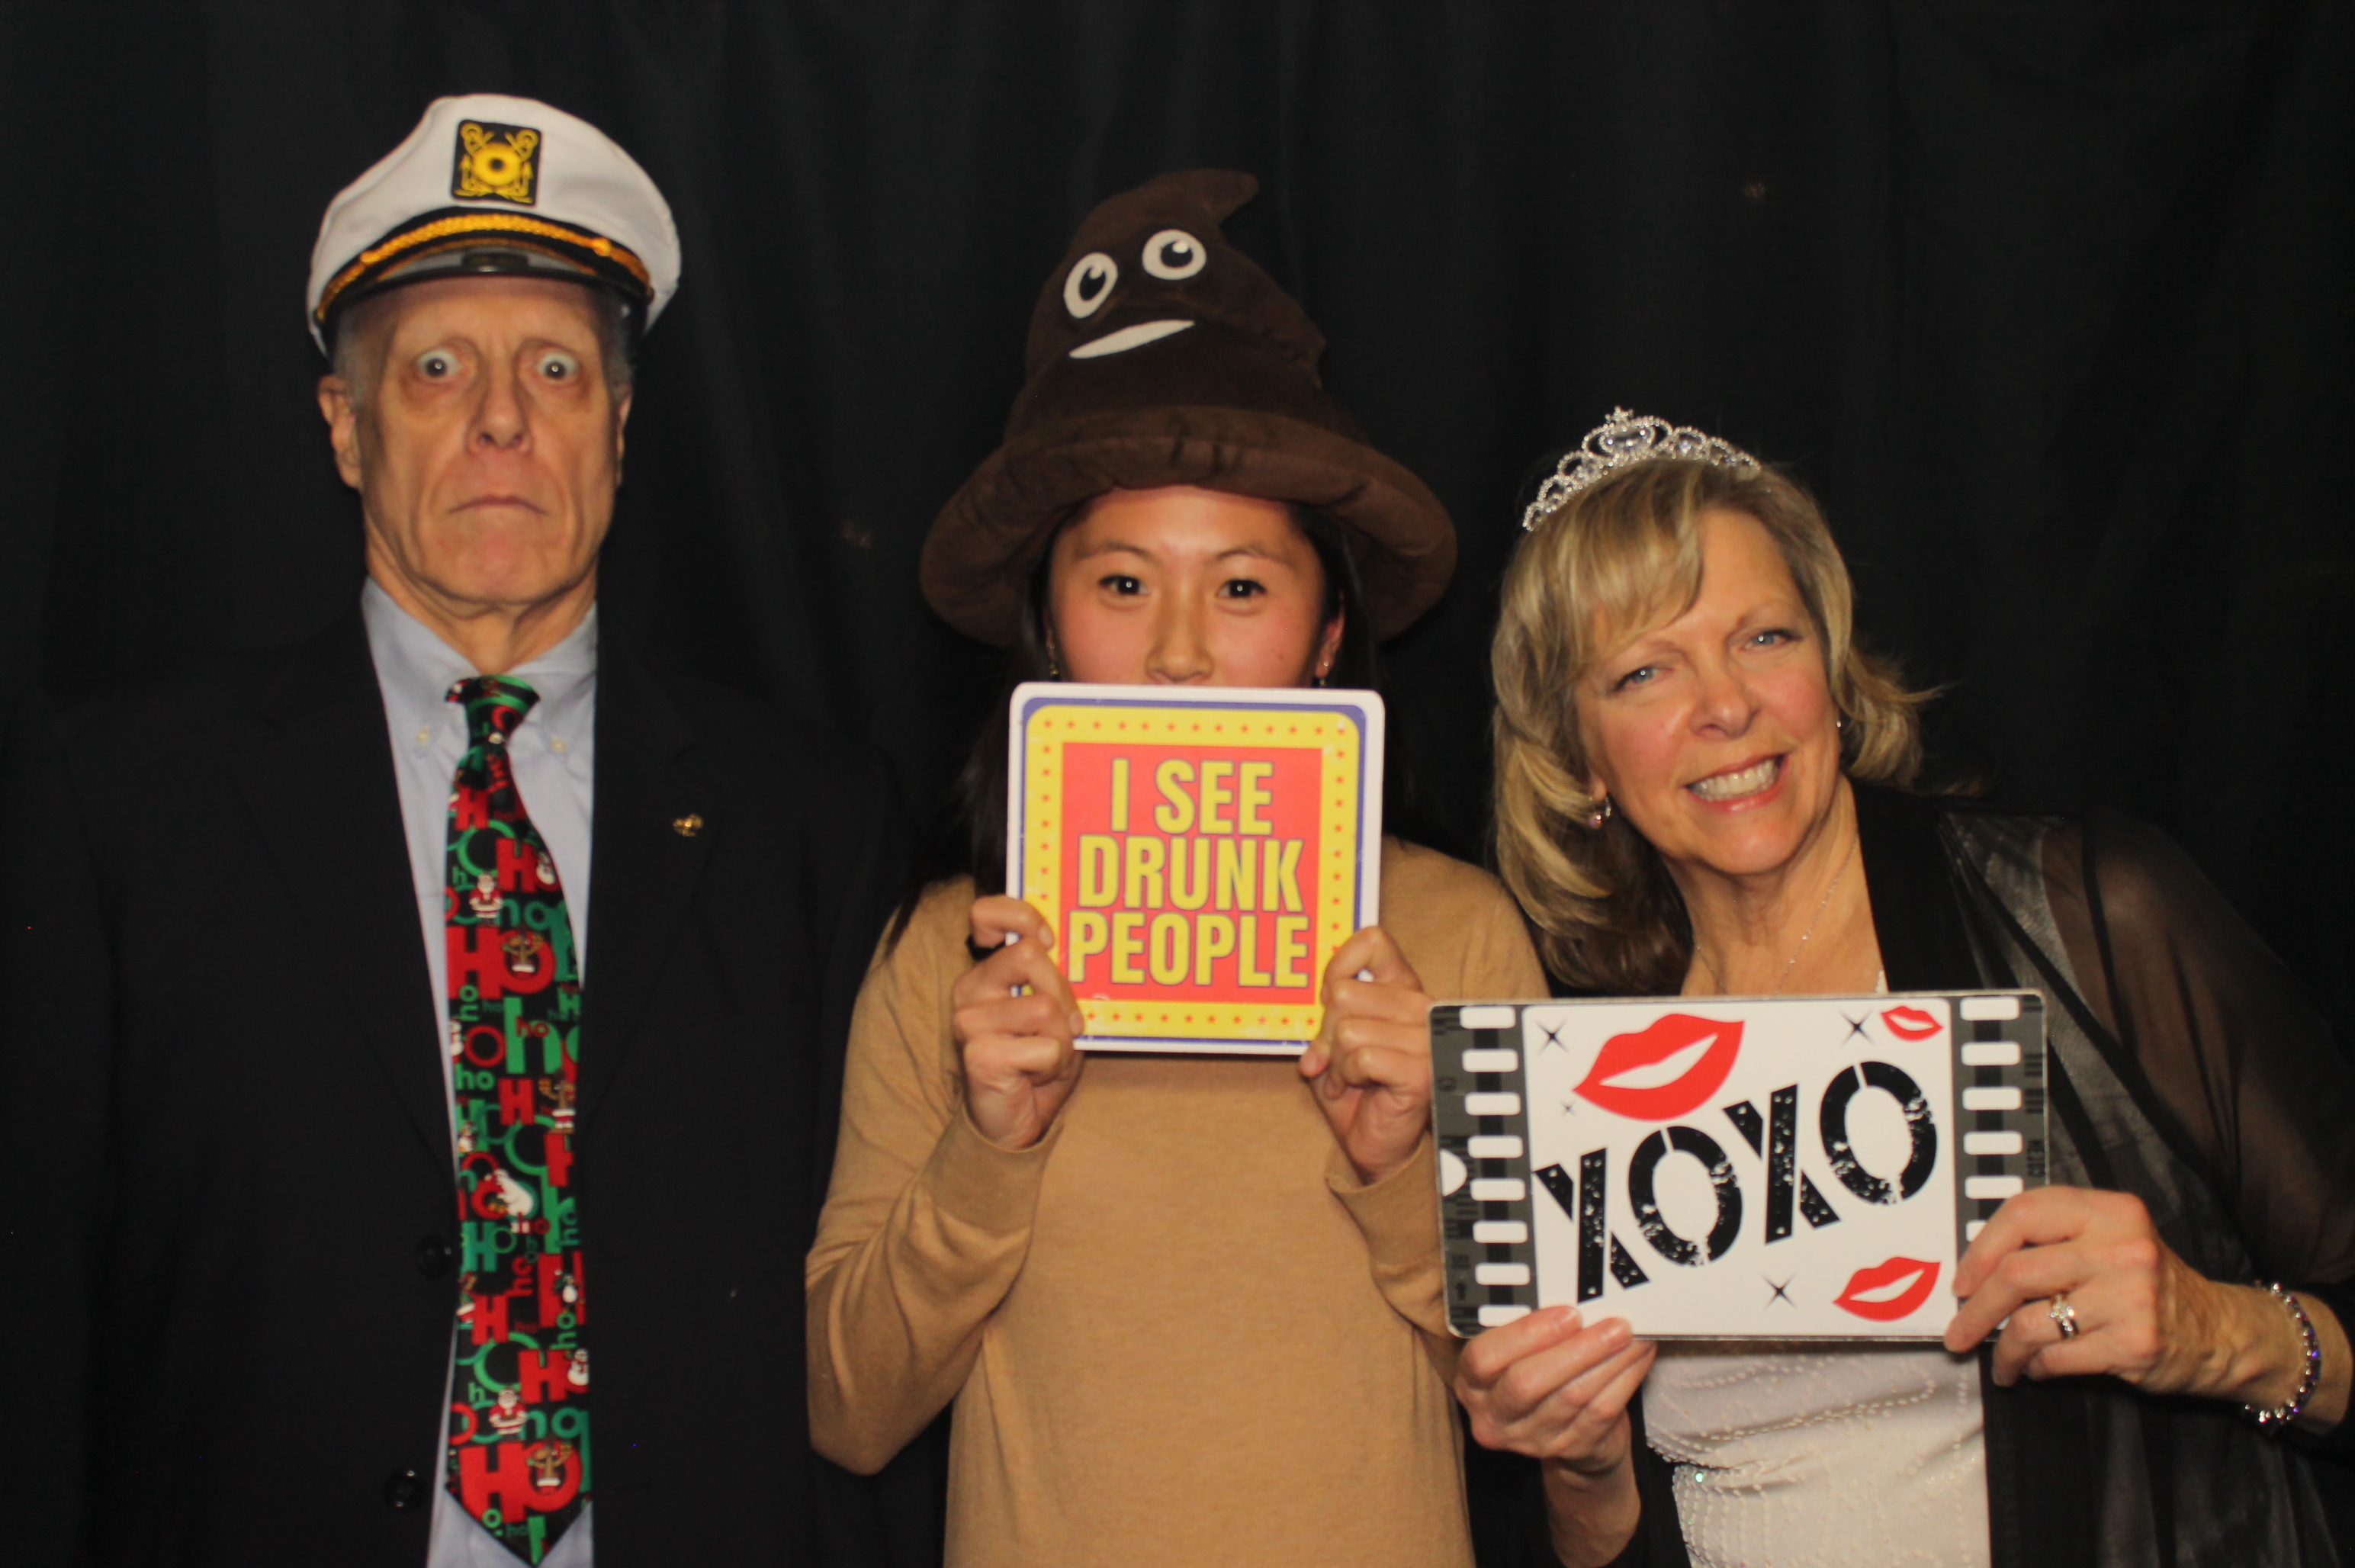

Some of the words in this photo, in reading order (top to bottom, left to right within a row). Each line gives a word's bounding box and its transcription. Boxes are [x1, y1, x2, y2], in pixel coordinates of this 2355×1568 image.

[1111, 757, 1129, 832] I
[1154, 758, 1273, 835] SEE
[1078, 835, 1304, 912] DRUNK
[1068, 911, 1309, 988] PEOPLE
[1532, 1061, 1939, 1305] XOXO
